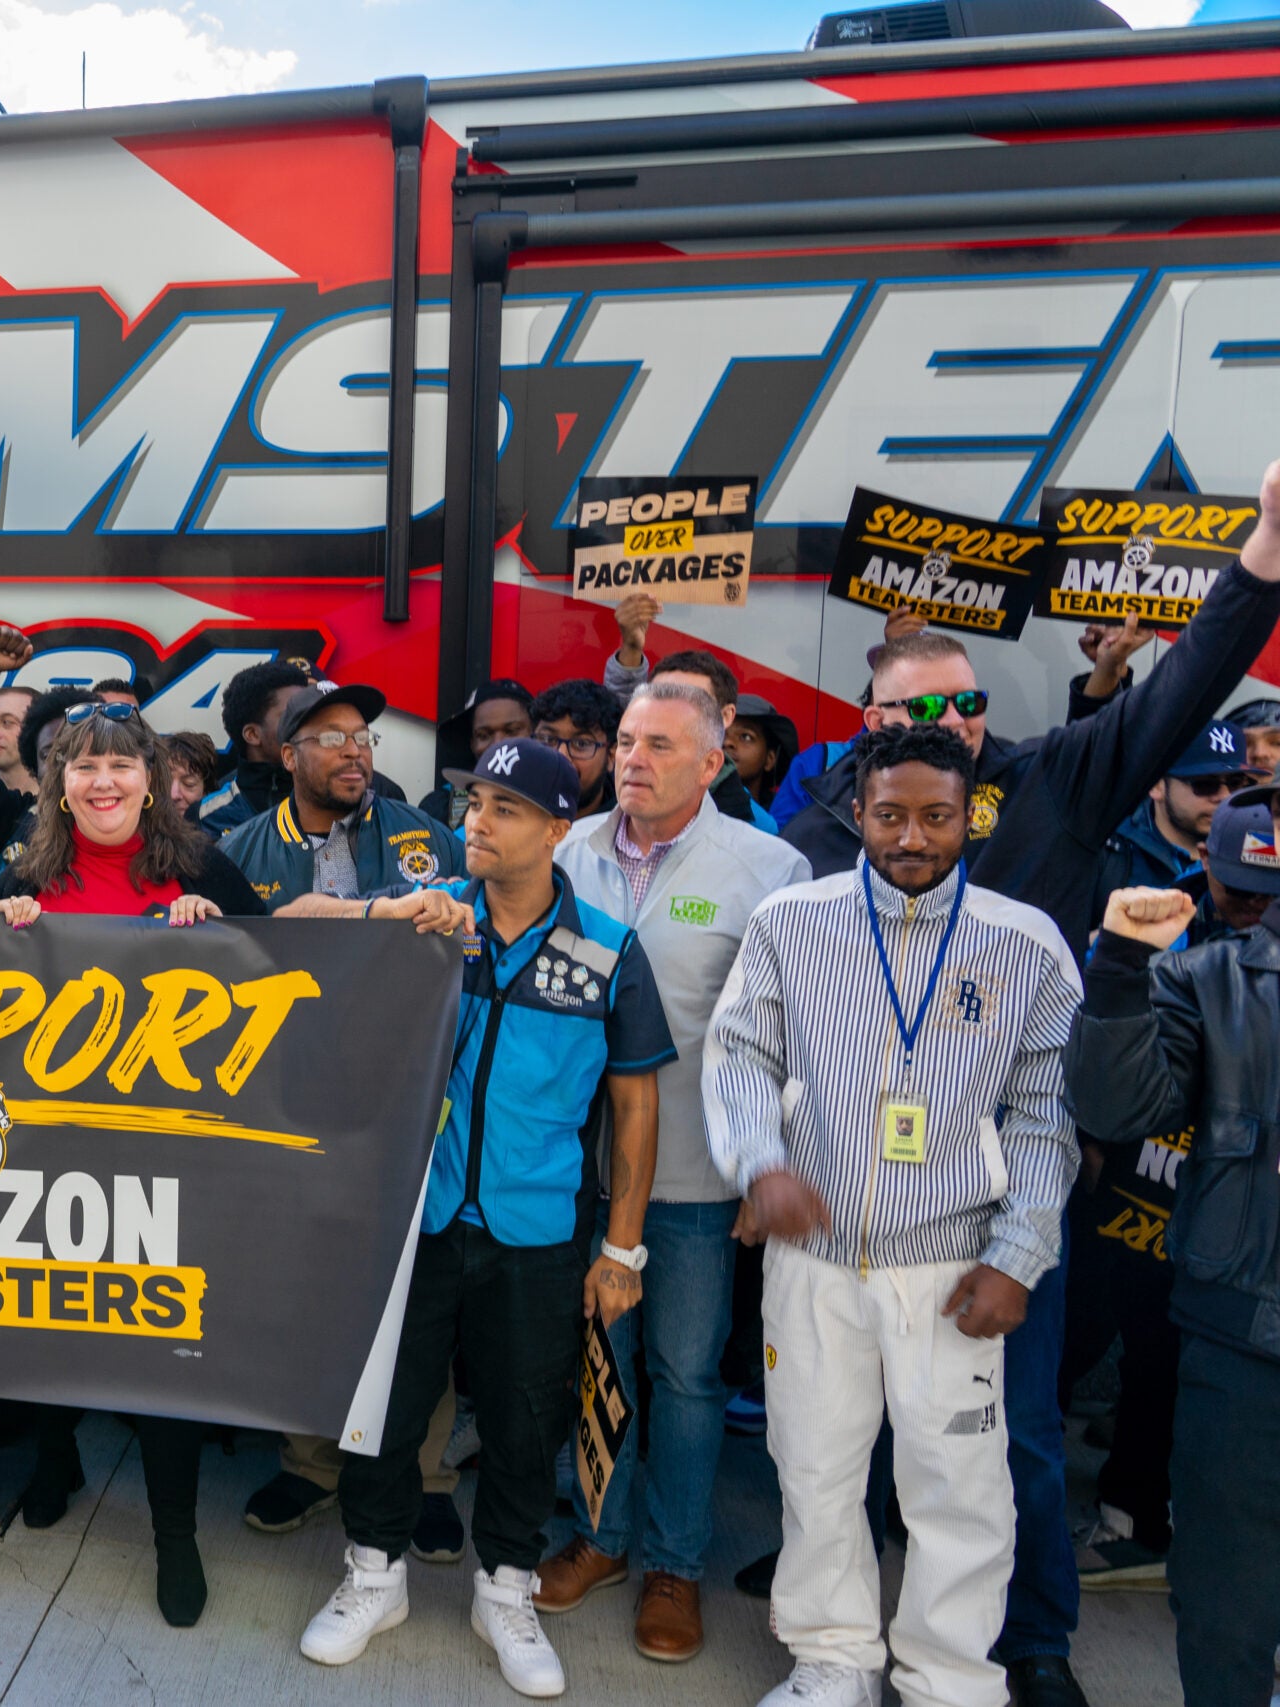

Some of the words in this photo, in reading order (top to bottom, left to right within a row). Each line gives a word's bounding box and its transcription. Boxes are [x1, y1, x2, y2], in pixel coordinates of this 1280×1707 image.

[579, 484, 751, 529] PEOPLE
[1057, 498, 1257, 541] SUPPORT
[629, 527, 687, 550] OVER
[865, 504, 1045, 563] SUPPORT
[577, 551, 746, 590] PACKAGES
[860, 555, 1006, 610] AMAZON
[1060, 558, 1220, 600] AMAZON
[857, 582, 999, 626] TEAMSTERS
[1057, 592, 1204, 618] TEAMSTER
[539, 989, 583, 1008] amazon
